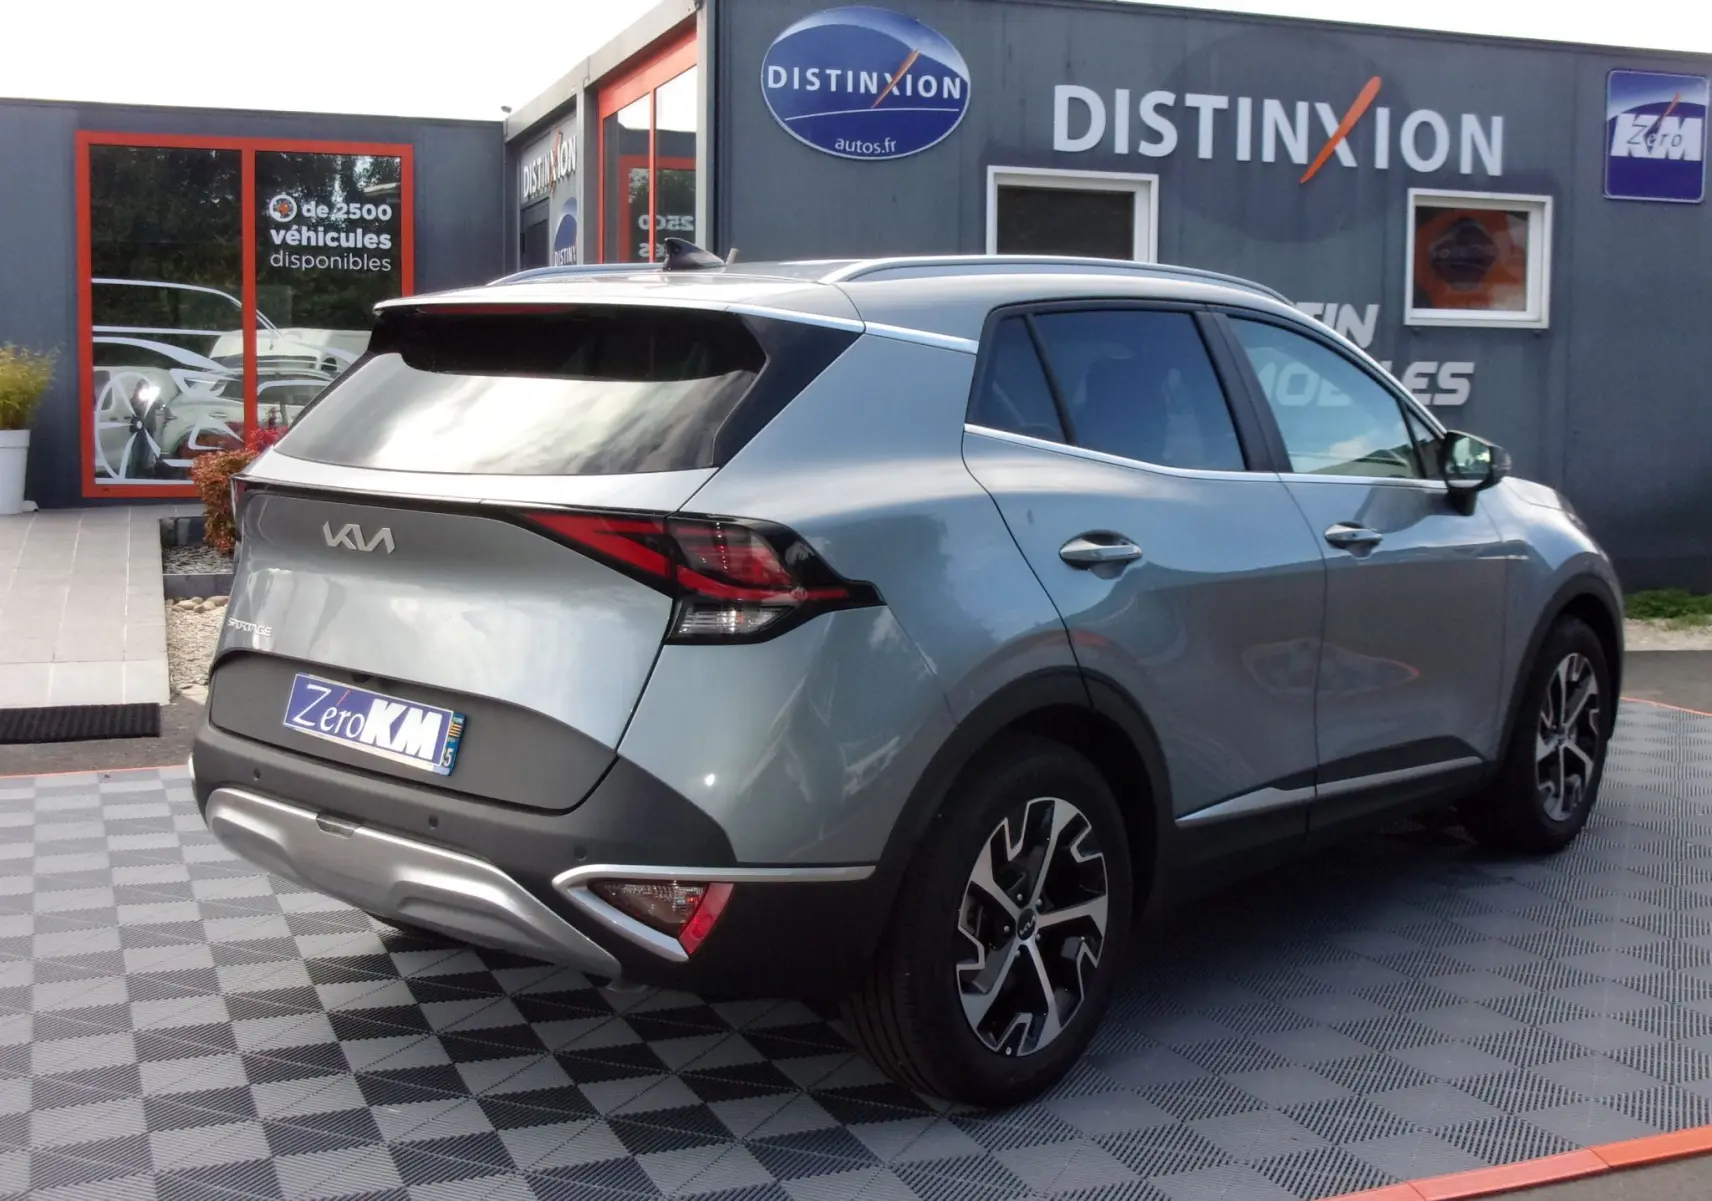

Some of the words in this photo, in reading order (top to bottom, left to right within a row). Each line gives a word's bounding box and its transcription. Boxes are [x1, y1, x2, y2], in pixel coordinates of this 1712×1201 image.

[768, 58, 961, 103] DISTINXION
[834, 136, 897, 155] autos.fr
[1053, 77, 1504, 184] DISTINXION
[1610, 113, 1703, 161] KM
[523, 130, 577, 198] DISTINXION
[301, 200, 330, 218] de
[335, 202, 393, 221] 2500
[270, 224, 392, 249] véhicules
[270, 249, 392, 272] disponibles
[322, 521, 396, 555] KIA
